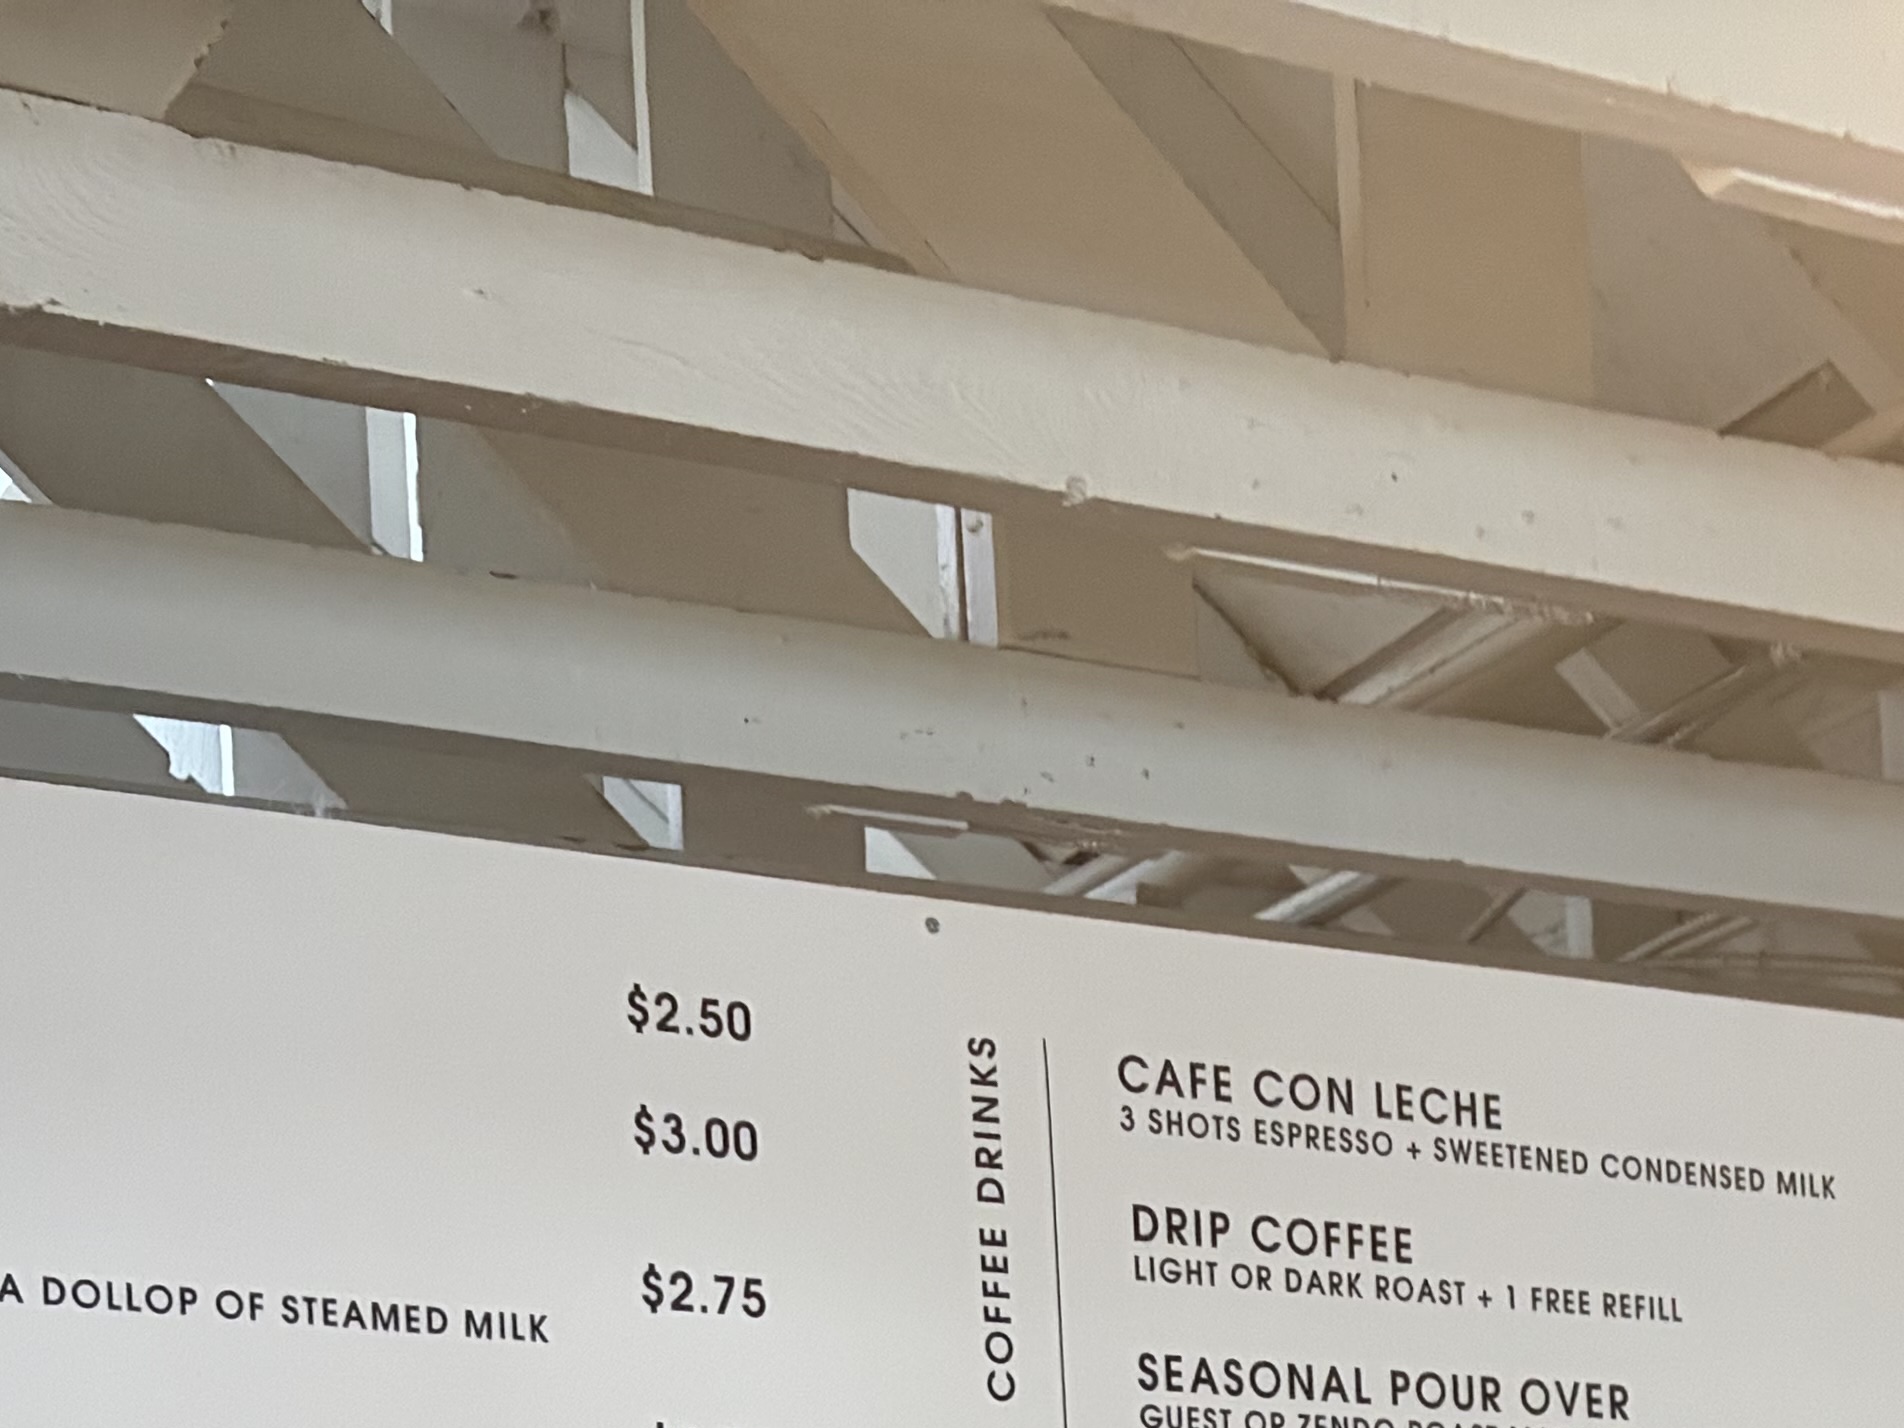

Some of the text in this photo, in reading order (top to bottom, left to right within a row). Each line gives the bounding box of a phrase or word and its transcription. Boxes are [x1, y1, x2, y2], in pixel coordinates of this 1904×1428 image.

[626, 981, 753, 1043] $2.50
[1116, 1053, 1504, 1132] CAFE CON LECHE
[632, 1102, 759, 1163] $3.00
[1118, 1103, 1137, 1134] 3
[1147, 1106, 1242, 1144] SHOTS
[1253, 1117, 1394, 1158] ESPRESSO
[1432, 1135, 1590, 1177] SWEETENED
[1599, 1152, 1766, 1194] CONDENSED
[1775, 1169, 1837, 1201] MILK
[966, 1036, 1017, 1403] COFFEE DRINKS
[1130, 1202, 1414, 1266] DRIP COFFEE
[41, 1274, 199, 1317] DOLLOP
[214, 1288, 265, 1323] OF
[280, 1293, 450, 1336] STEAMED
[463, 1308, 551, 1345] MILK
[640, 1261, 768, 1320] $2.75
[1136, 1350, 1631, 1422] SEASONAL POUR OVER
